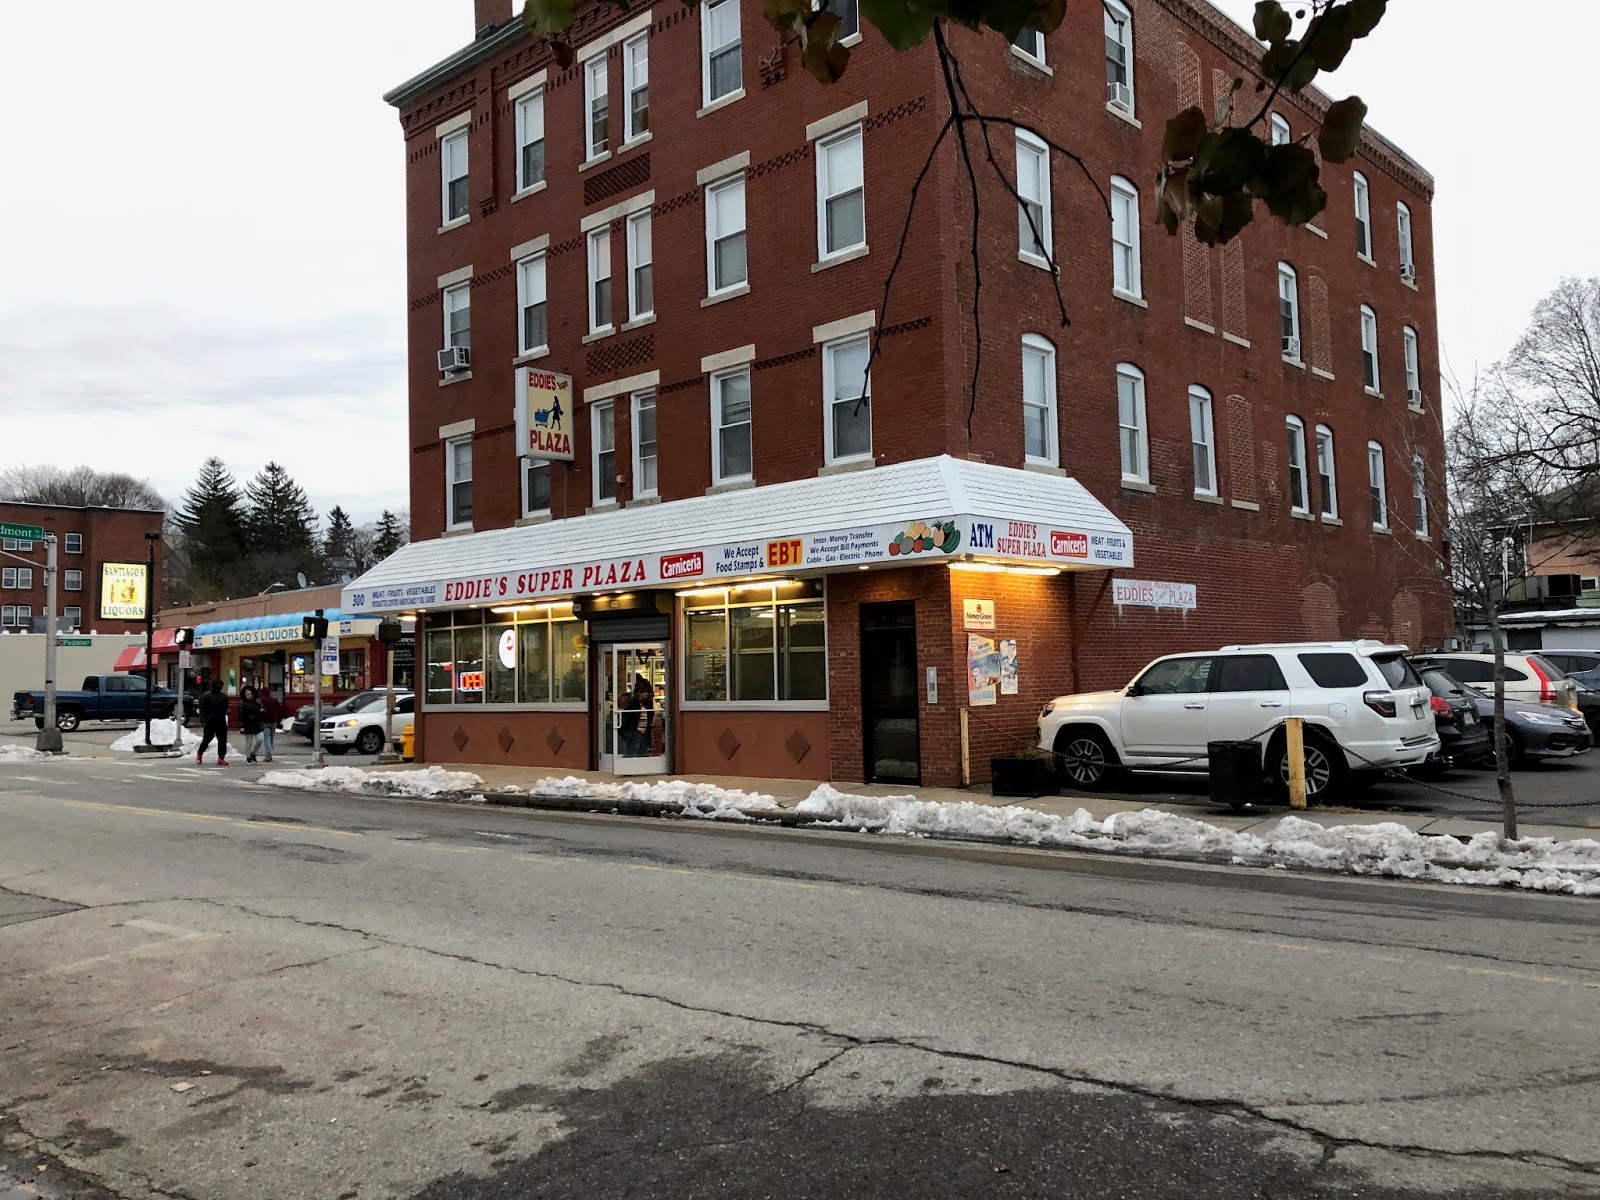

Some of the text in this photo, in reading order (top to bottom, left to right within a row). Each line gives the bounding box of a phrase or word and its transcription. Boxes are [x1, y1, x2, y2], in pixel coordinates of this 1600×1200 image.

[529, 429, 571, 454] PLAZA
[829, 535, 848, 543] Money
[849, 531, 874, 540] Transfer
[969, 522, 994, 548] ATM
[1008, 521, 1037, 539] EDDIE'S
[724, 541, 759, 559] We Accept
[820, 545, 839, 554] Accept
[840, 543, 850, 551] Bill
[850, 540, 879, 551] Payments
[997, 537, 1047, 557] SUPER PLAZA
[1052, 535, 1087, 554] Carniceria
[1091, 536, 1126, 548] MEAT FRUITS &
[768, 540, 801, 566] EBT
[806, 550, 884, 564] Cable Gas Electric Phone
[1094, 549, 1123, 560] VEGETABLES
[662, 554, 702, 578] Carniceria
[716, 557, 764, 573] Food Stamps &
[444, 559, 646, 601] EDDIE'S SUPER PLAZA
[352, 593, 365, 606] 300
[372, 585, 436, 598] MEAT FRUITS VEGETABLES
[1116, 586, 1153, 602] EDDIES
[1168, 590, 1194, 605] PLAZA
[103, 606, 144, 616] LIQUORS
[212, 628, 299, 645] SANTIAGO'S LIQUORS
[462, 673, 484, 690] OPEN
